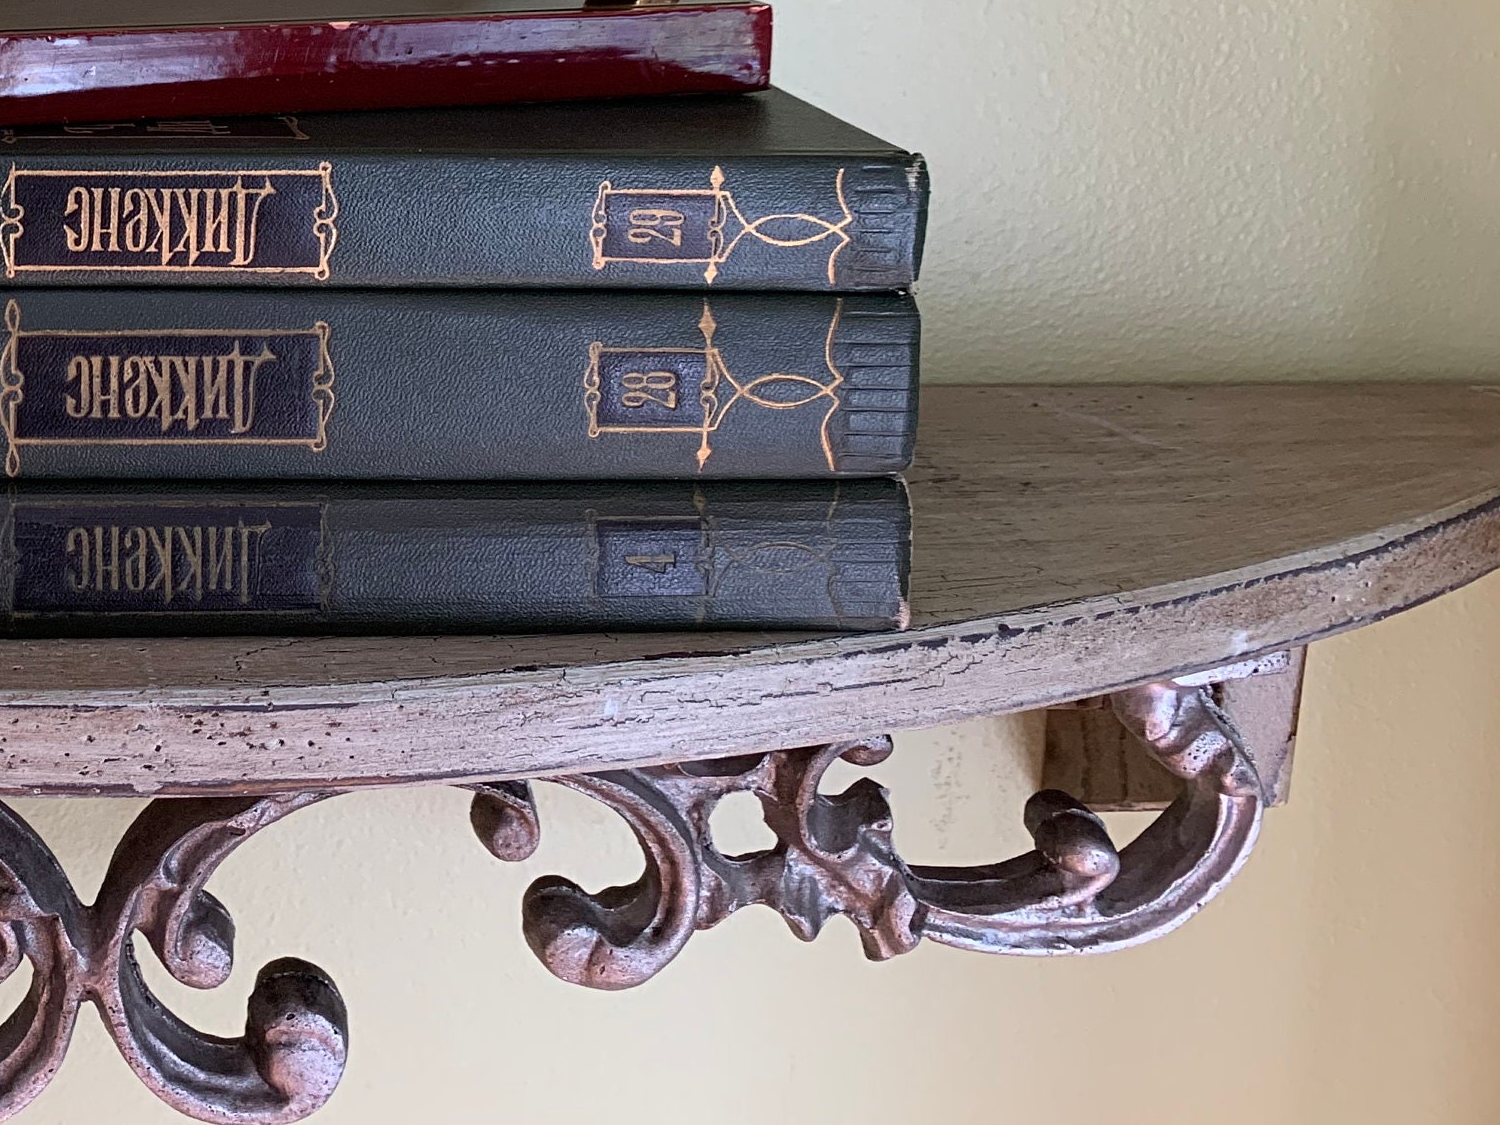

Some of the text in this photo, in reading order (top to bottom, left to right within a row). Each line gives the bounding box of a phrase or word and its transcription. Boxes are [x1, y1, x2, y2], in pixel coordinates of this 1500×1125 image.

[628, 208, 685, 247] 29
[621, 371, 678, 410] 28
[623, 552, 677, 575] 4
